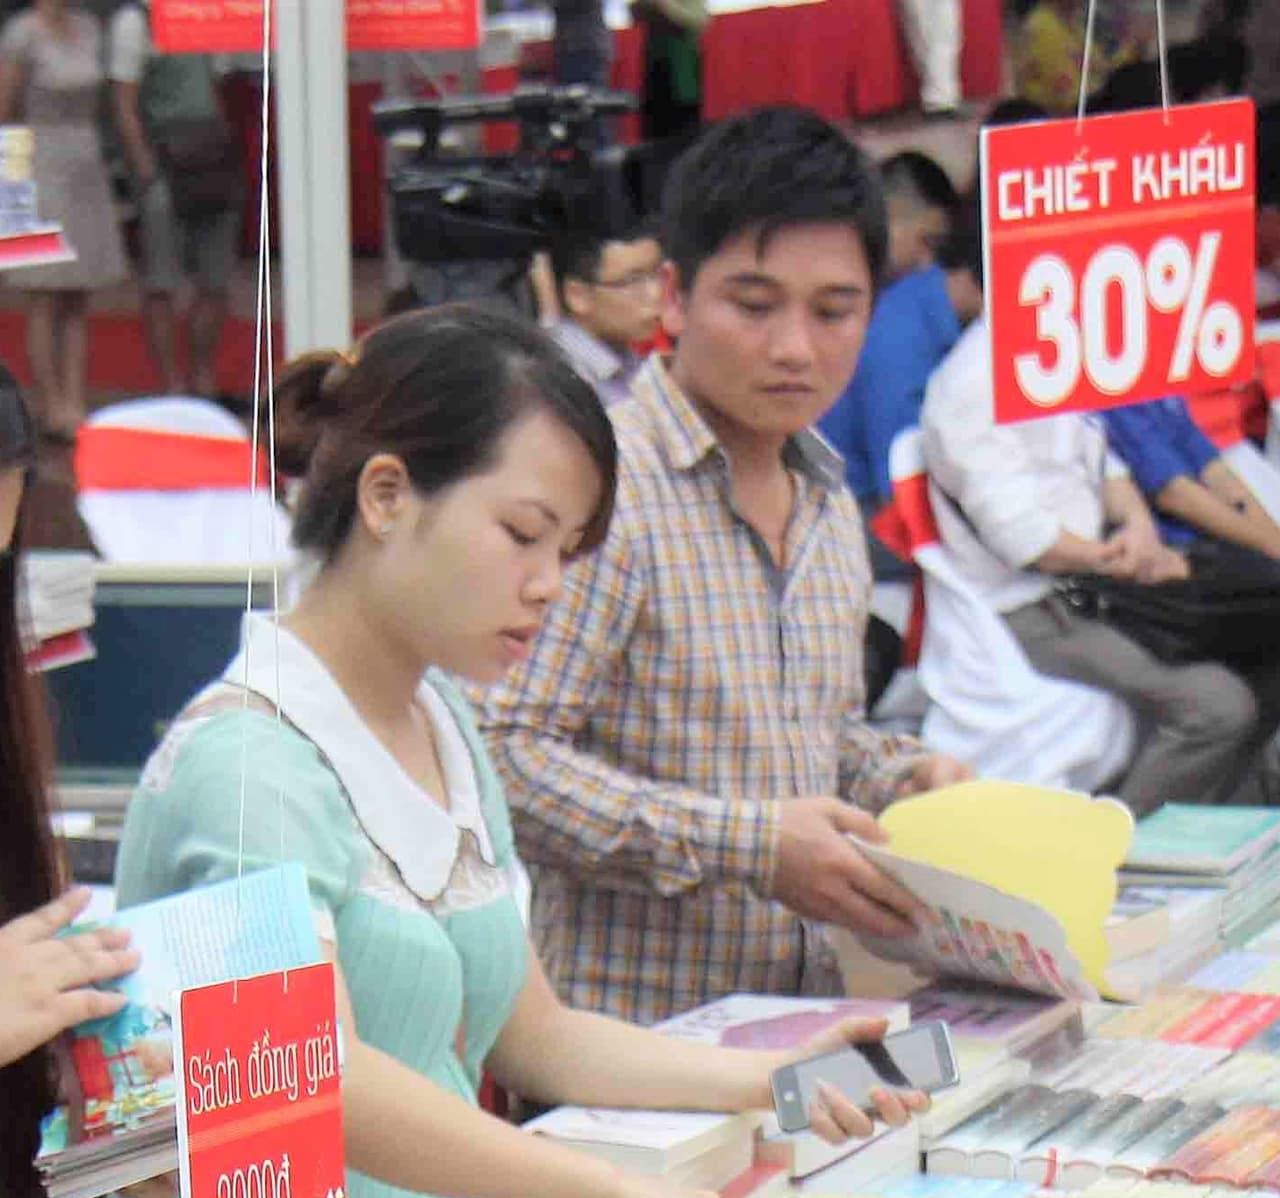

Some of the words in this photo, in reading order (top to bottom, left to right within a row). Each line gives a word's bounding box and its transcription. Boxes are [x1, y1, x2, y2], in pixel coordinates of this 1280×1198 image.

[997, 146, 1117, 221] CHIẾT
[1132, 131, 1245, 202] KHẤU
[1013, 232, 1243, 407] 30%
[188, 1043, 241, 1116] Sách
[247, 1029, 299, 1104] đồng
[305, 1019, 335, 1094] giá
